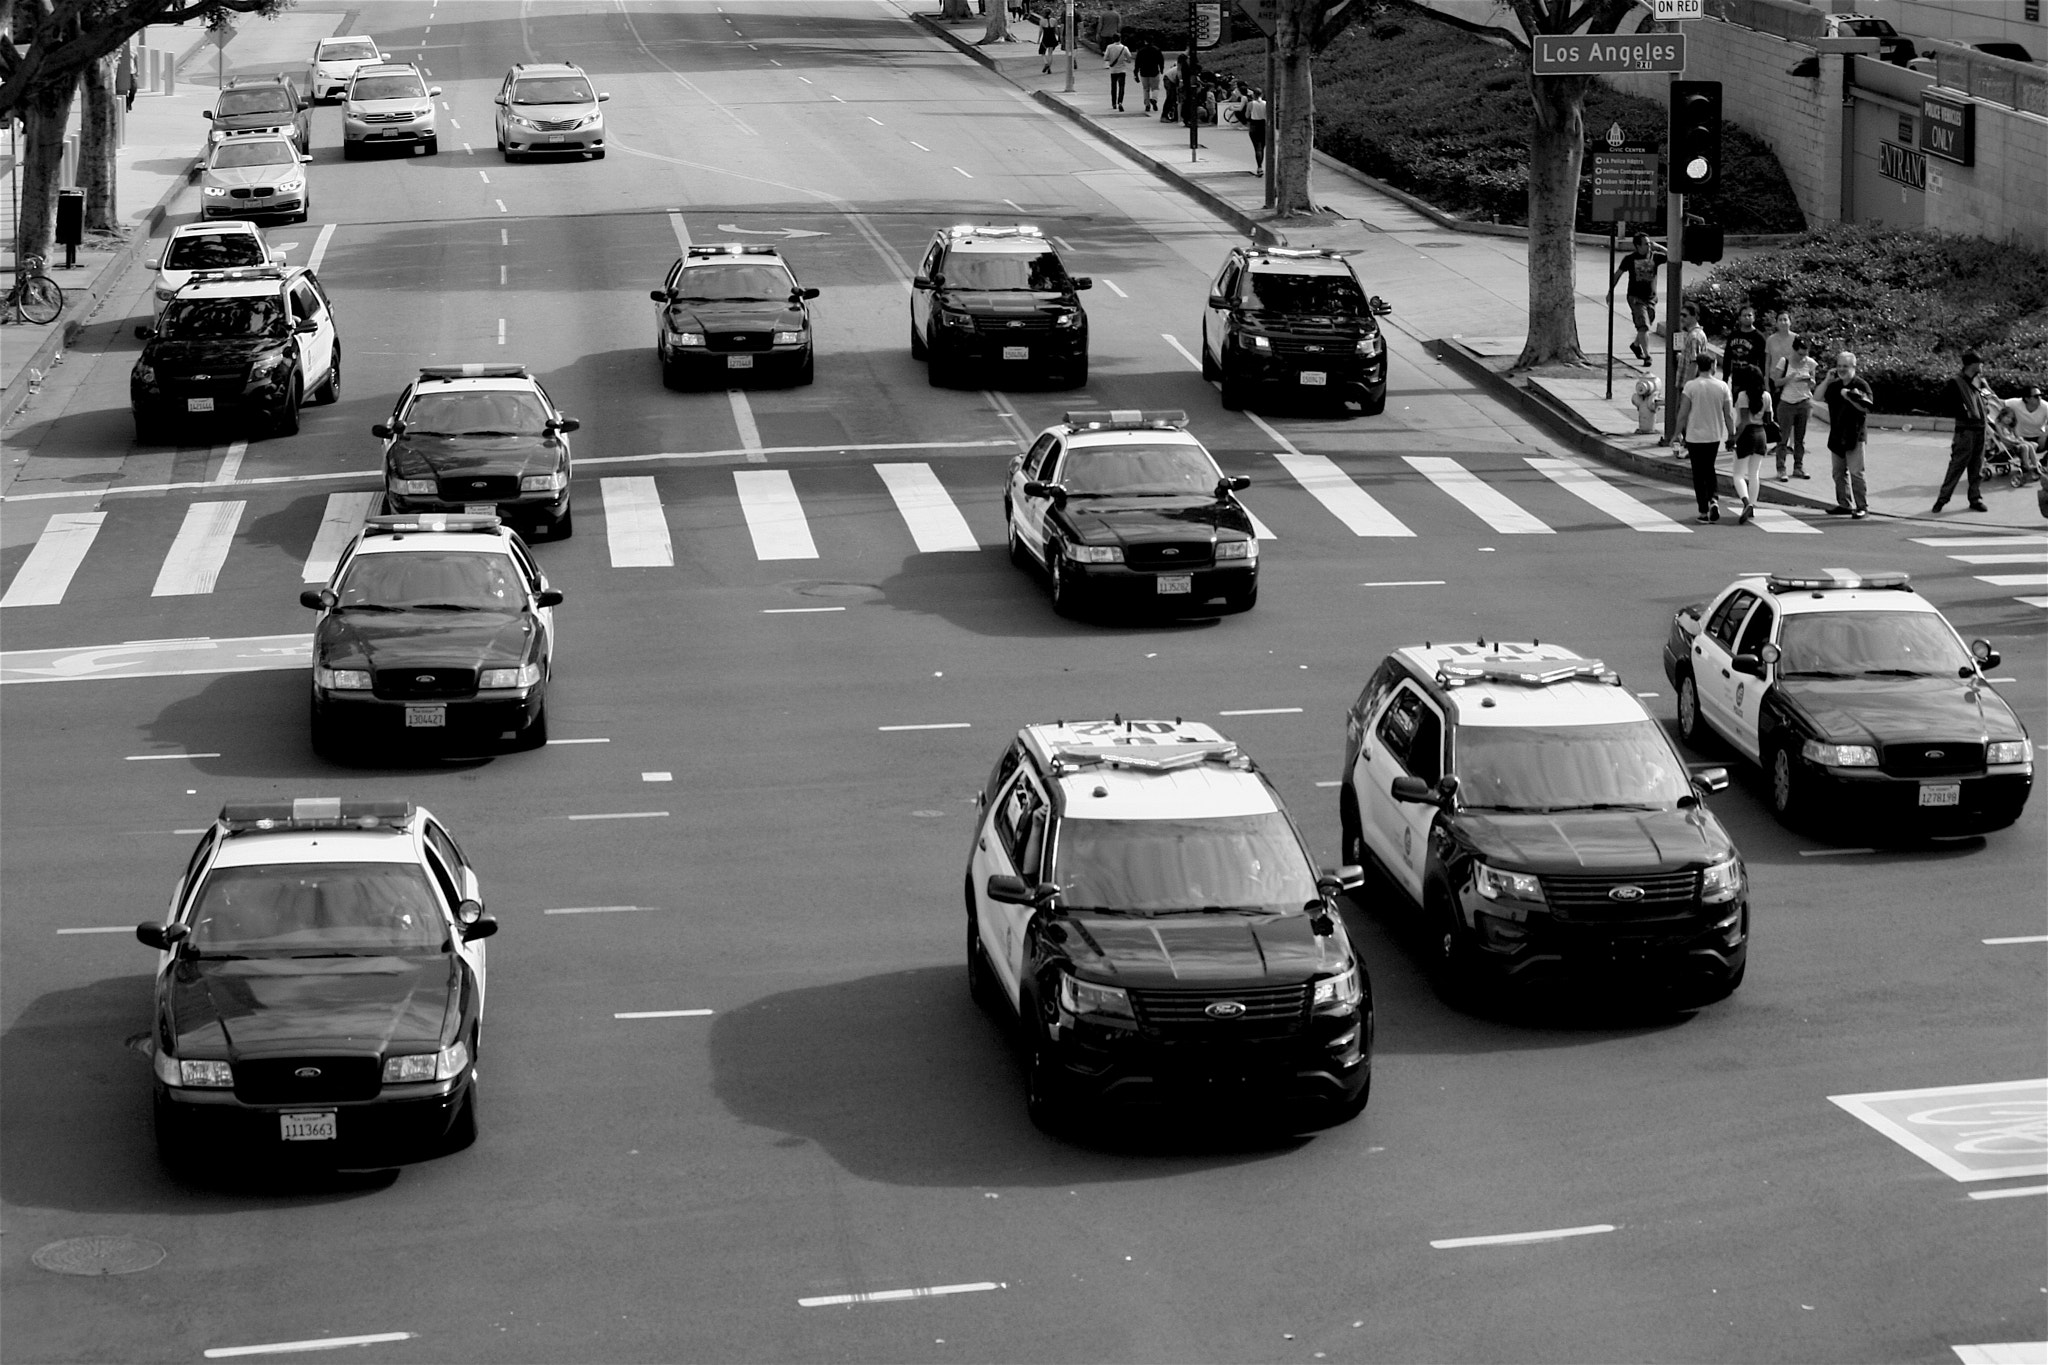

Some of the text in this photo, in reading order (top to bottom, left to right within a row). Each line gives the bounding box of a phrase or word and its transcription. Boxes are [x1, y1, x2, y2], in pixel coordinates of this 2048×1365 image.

[1658, 0, 1699, 12] ON RED
[1543, 42, 1675, 67] Los Angeles
[1924, 101, 1962, 127] POLICE VEHICLES
[1931, 125, 1954, 152] ONLY
[1880, 142, 1925, 189] ENTRANC
[408, 714, 444, 725] 1304427
[1922, 793, 1957, 803] 1278198
[286, 1123, 332, 1137] 1113663
